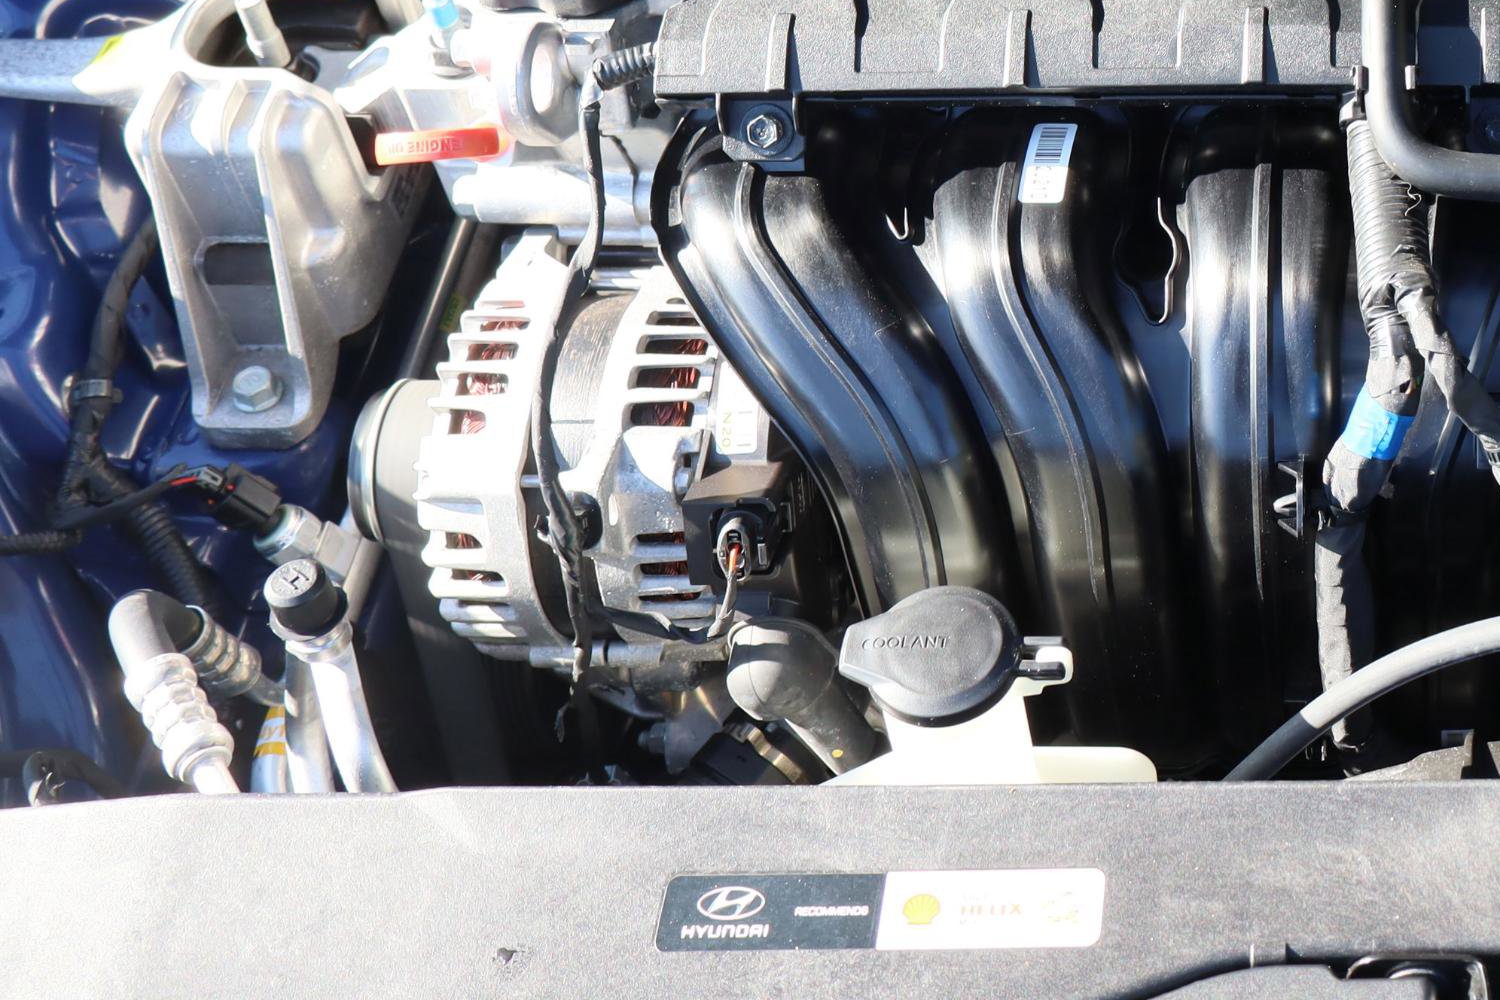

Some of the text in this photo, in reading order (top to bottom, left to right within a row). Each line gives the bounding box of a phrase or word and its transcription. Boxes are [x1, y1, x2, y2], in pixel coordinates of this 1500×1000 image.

[408, 138, 465, 153] ENGINE
[861, 634, 951, 651] COOLANT
[793, 904, 870, 918] RECOMMENDS
[680, 923, 771, 940] HYUNDAI
